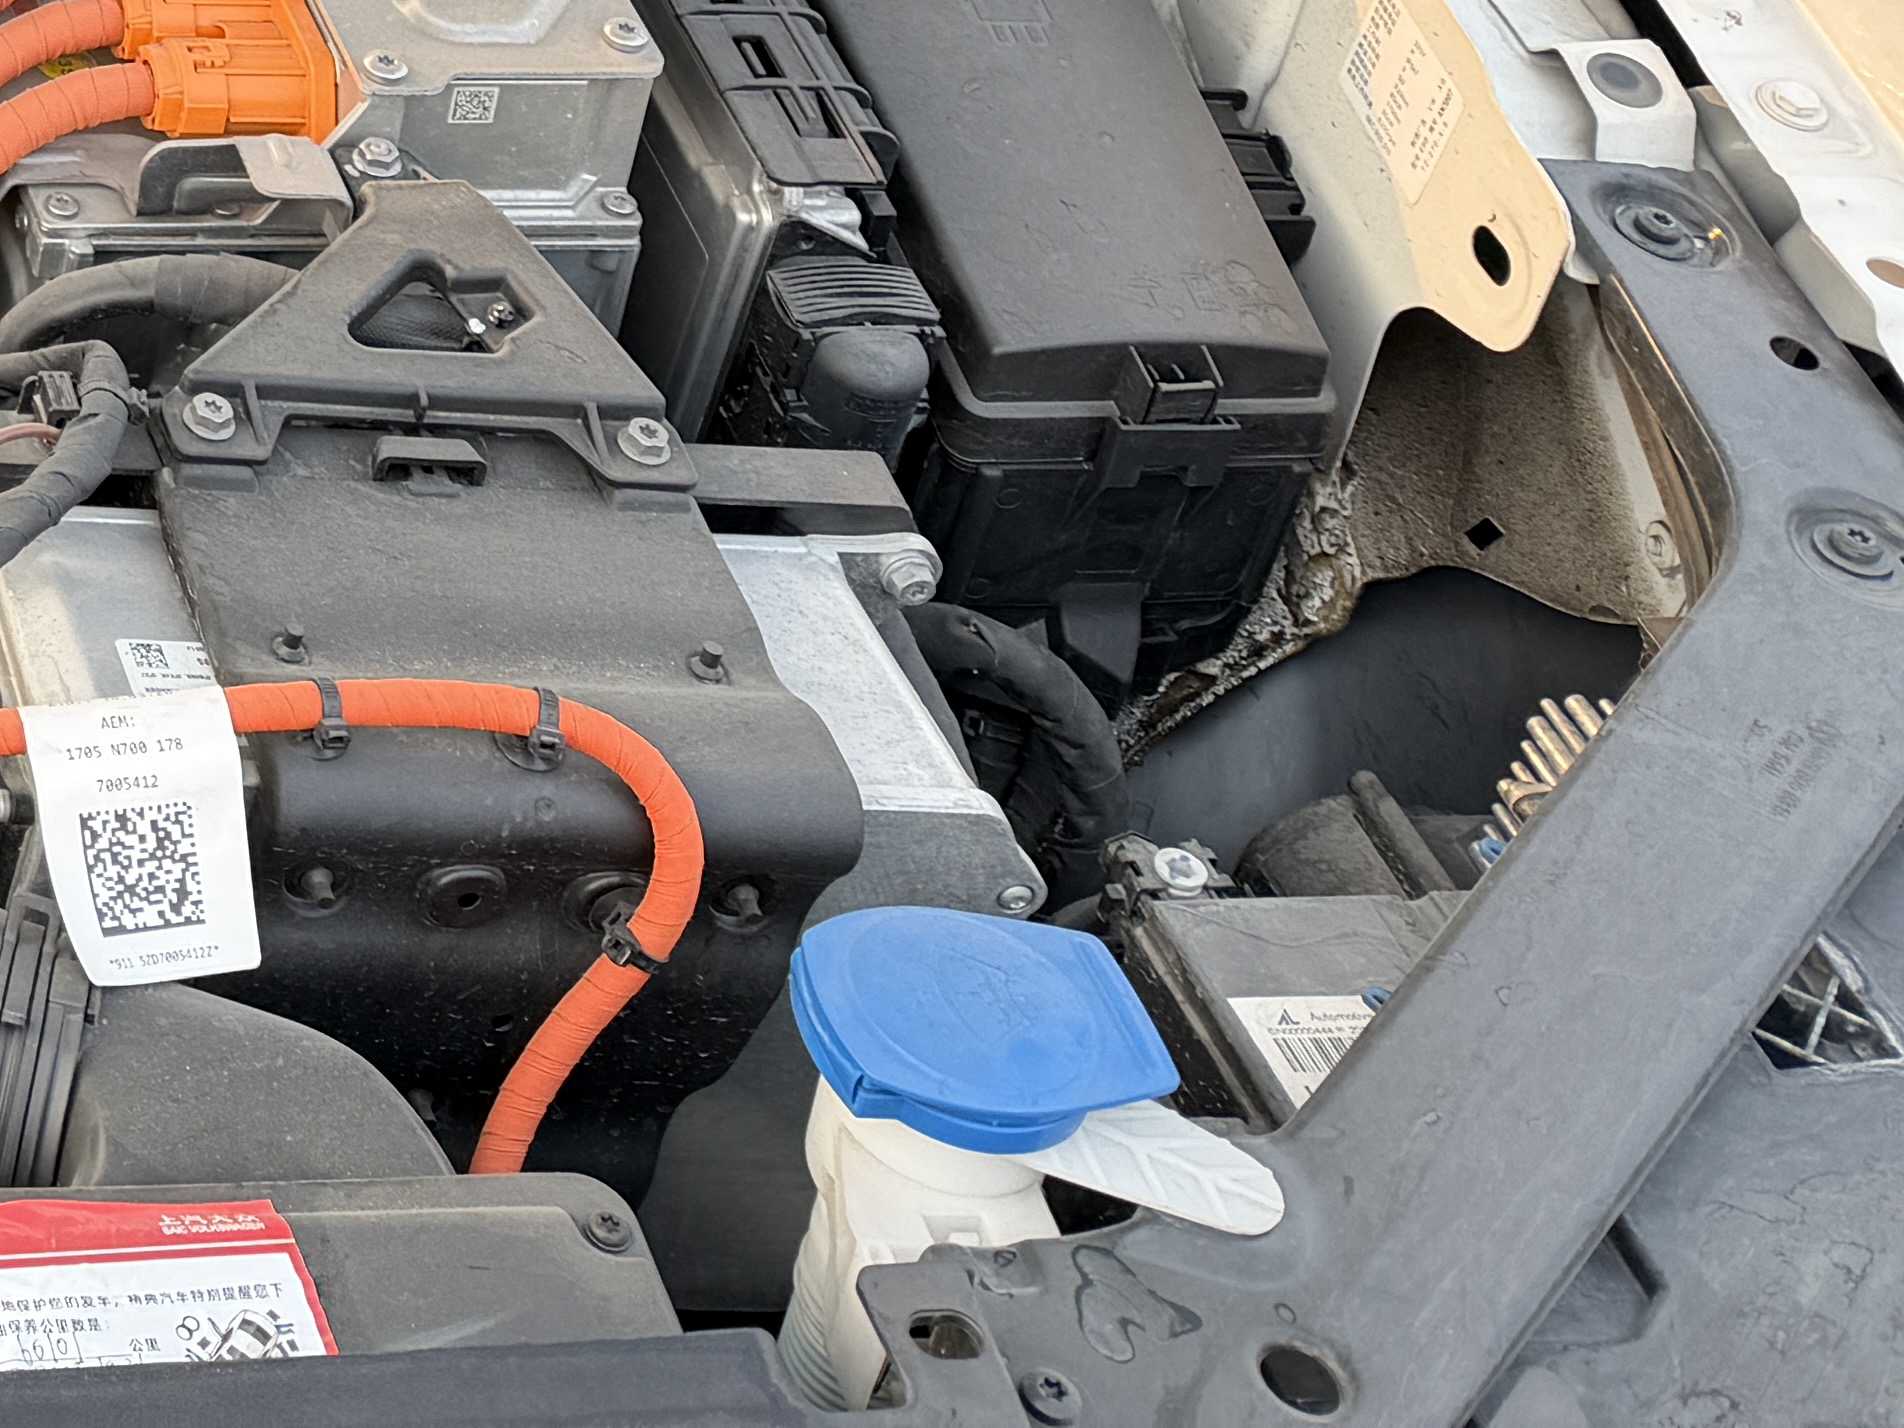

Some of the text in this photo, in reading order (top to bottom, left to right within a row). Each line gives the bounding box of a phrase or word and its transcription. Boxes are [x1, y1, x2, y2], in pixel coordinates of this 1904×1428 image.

[65, 737, 184, 761] 1705 N700 178
[96, 774, 159, 793] 7005412
[128, 1336, 161, 1352] 公里
